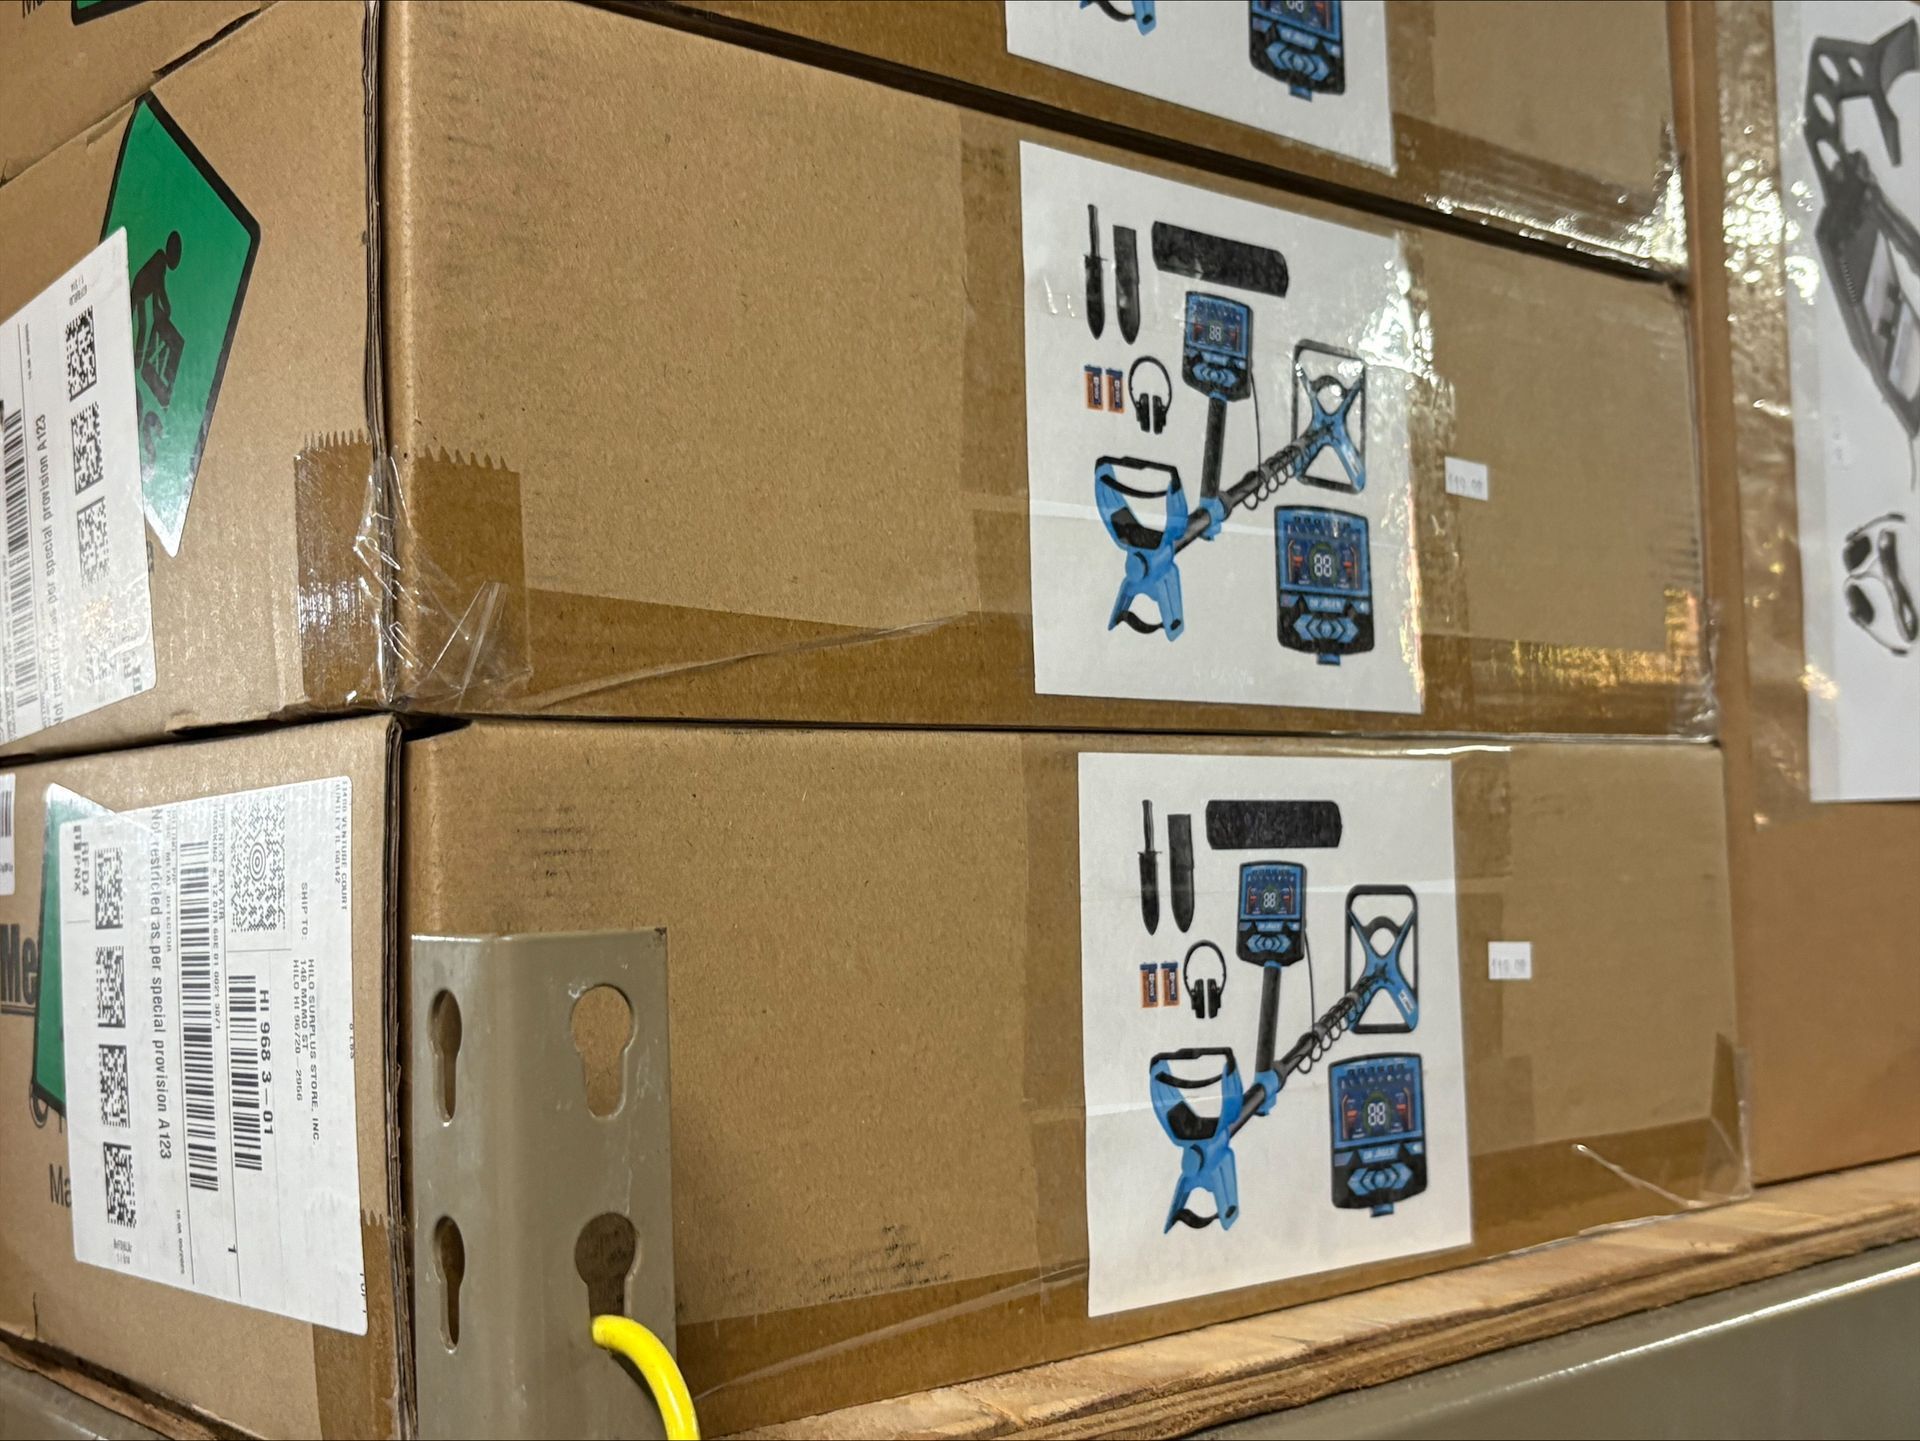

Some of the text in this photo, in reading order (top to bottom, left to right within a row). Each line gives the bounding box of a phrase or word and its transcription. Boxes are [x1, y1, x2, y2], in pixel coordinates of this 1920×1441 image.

[35, 413, 49, 451] A123
[38, 454, 53, 520] provision
[40, 525, 56, 576] special
[1313, 553, 1333, 578] 88
[300, 881, 308, 940] SHIP TO:
[148, 807, 172, 1160] Not restricted as per special provision A123
[259, 989, 270, 1012] HI
[293, 995, 300, 1010] HI
[300, 988, 308, 1030] MAMO
[260, 1022, 272, 1061] 968
[302, 1034, 309, 1051] ST
[307, 958, 320, 1145] HILO SURPLUS STORE, INC.
[1367, 1102, 1387, 1127] 88
